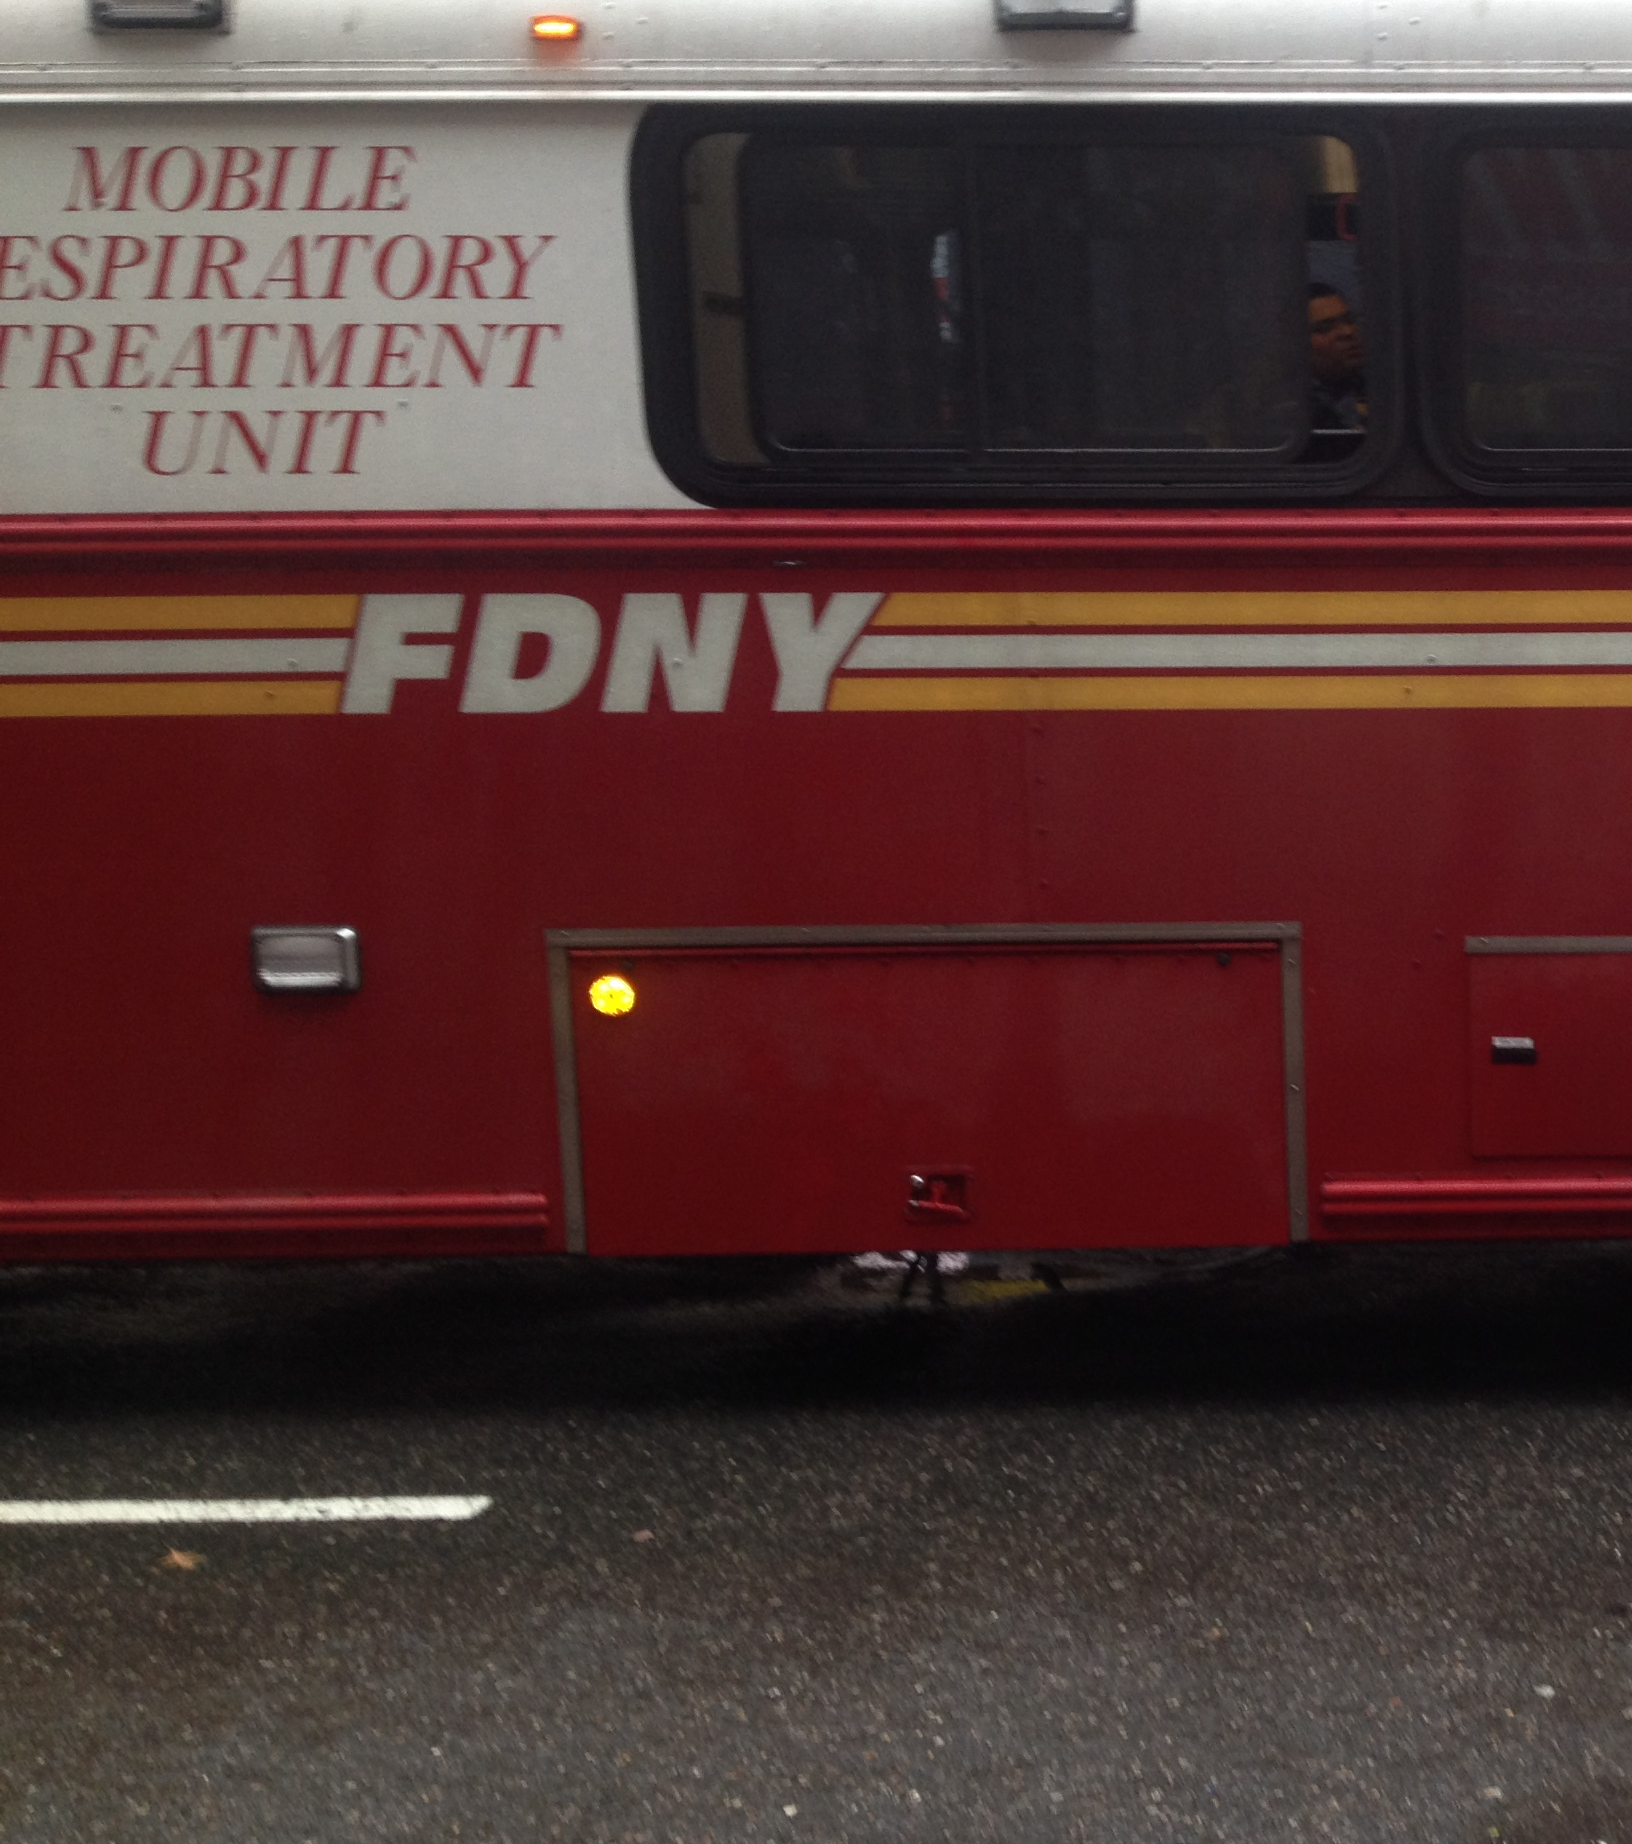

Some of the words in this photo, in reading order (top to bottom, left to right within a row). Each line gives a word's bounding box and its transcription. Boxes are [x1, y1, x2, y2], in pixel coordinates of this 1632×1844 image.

[62, 145, 418, 212] MOBILE
[0, 234, 558, 301] ESPIRATORY
[0, 322, 564, 389] TREATMENT
[141, 409, 387, 476] UNIT
[340, 591, 887, 715] FDNY
